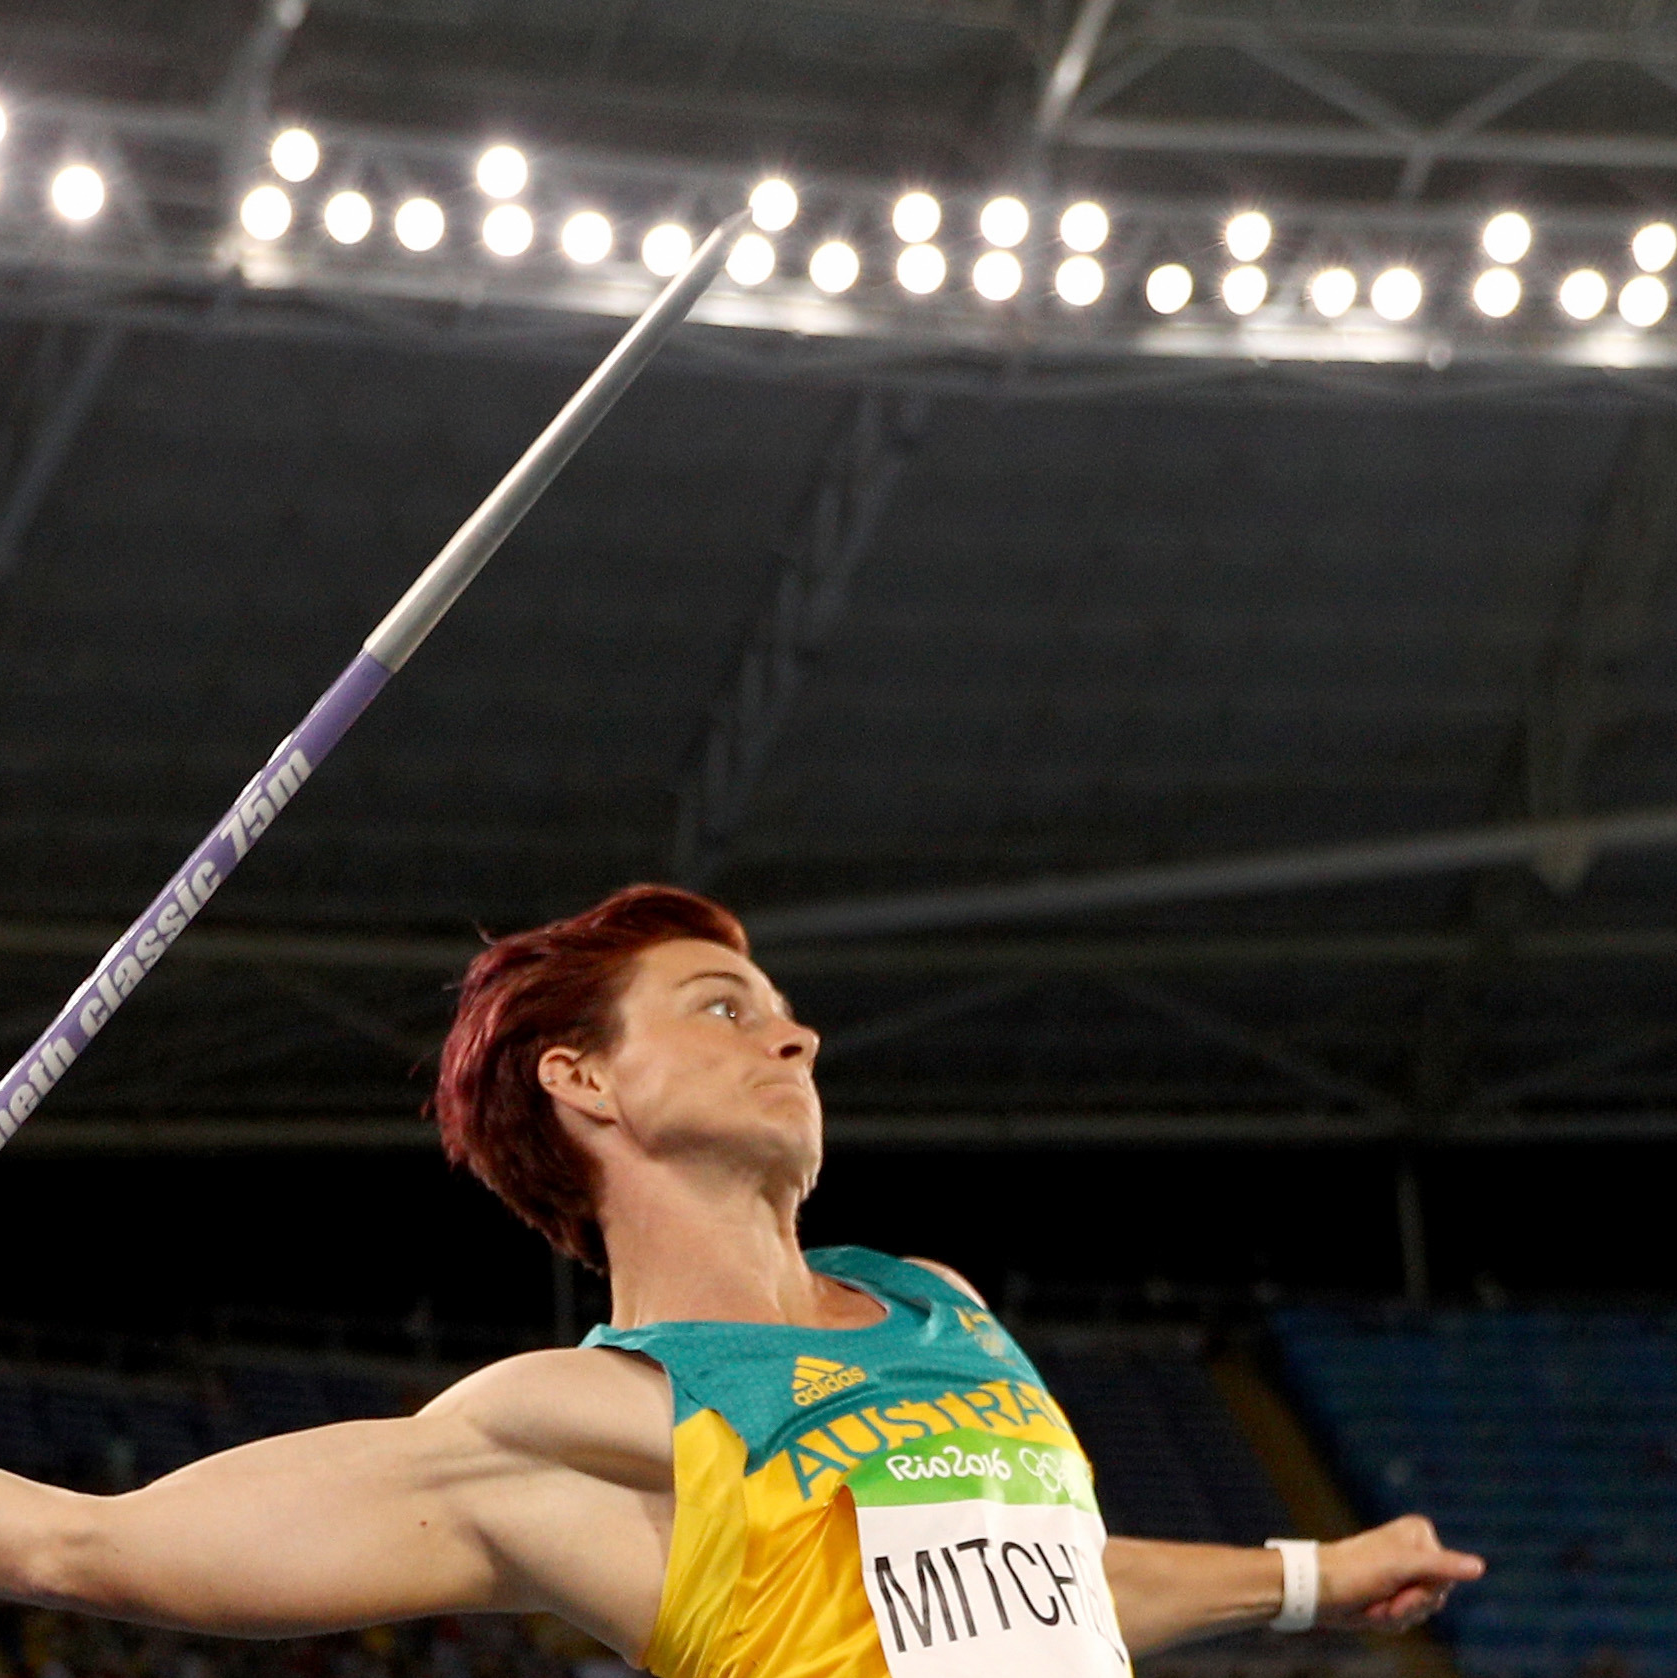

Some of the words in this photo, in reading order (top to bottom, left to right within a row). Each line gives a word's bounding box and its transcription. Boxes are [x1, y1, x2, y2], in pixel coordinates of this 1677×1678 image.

[79, 860, 222, 1038] classic
[220, 748, 312, 862] 75m
[793, 1365, 868, 1407] adidas
